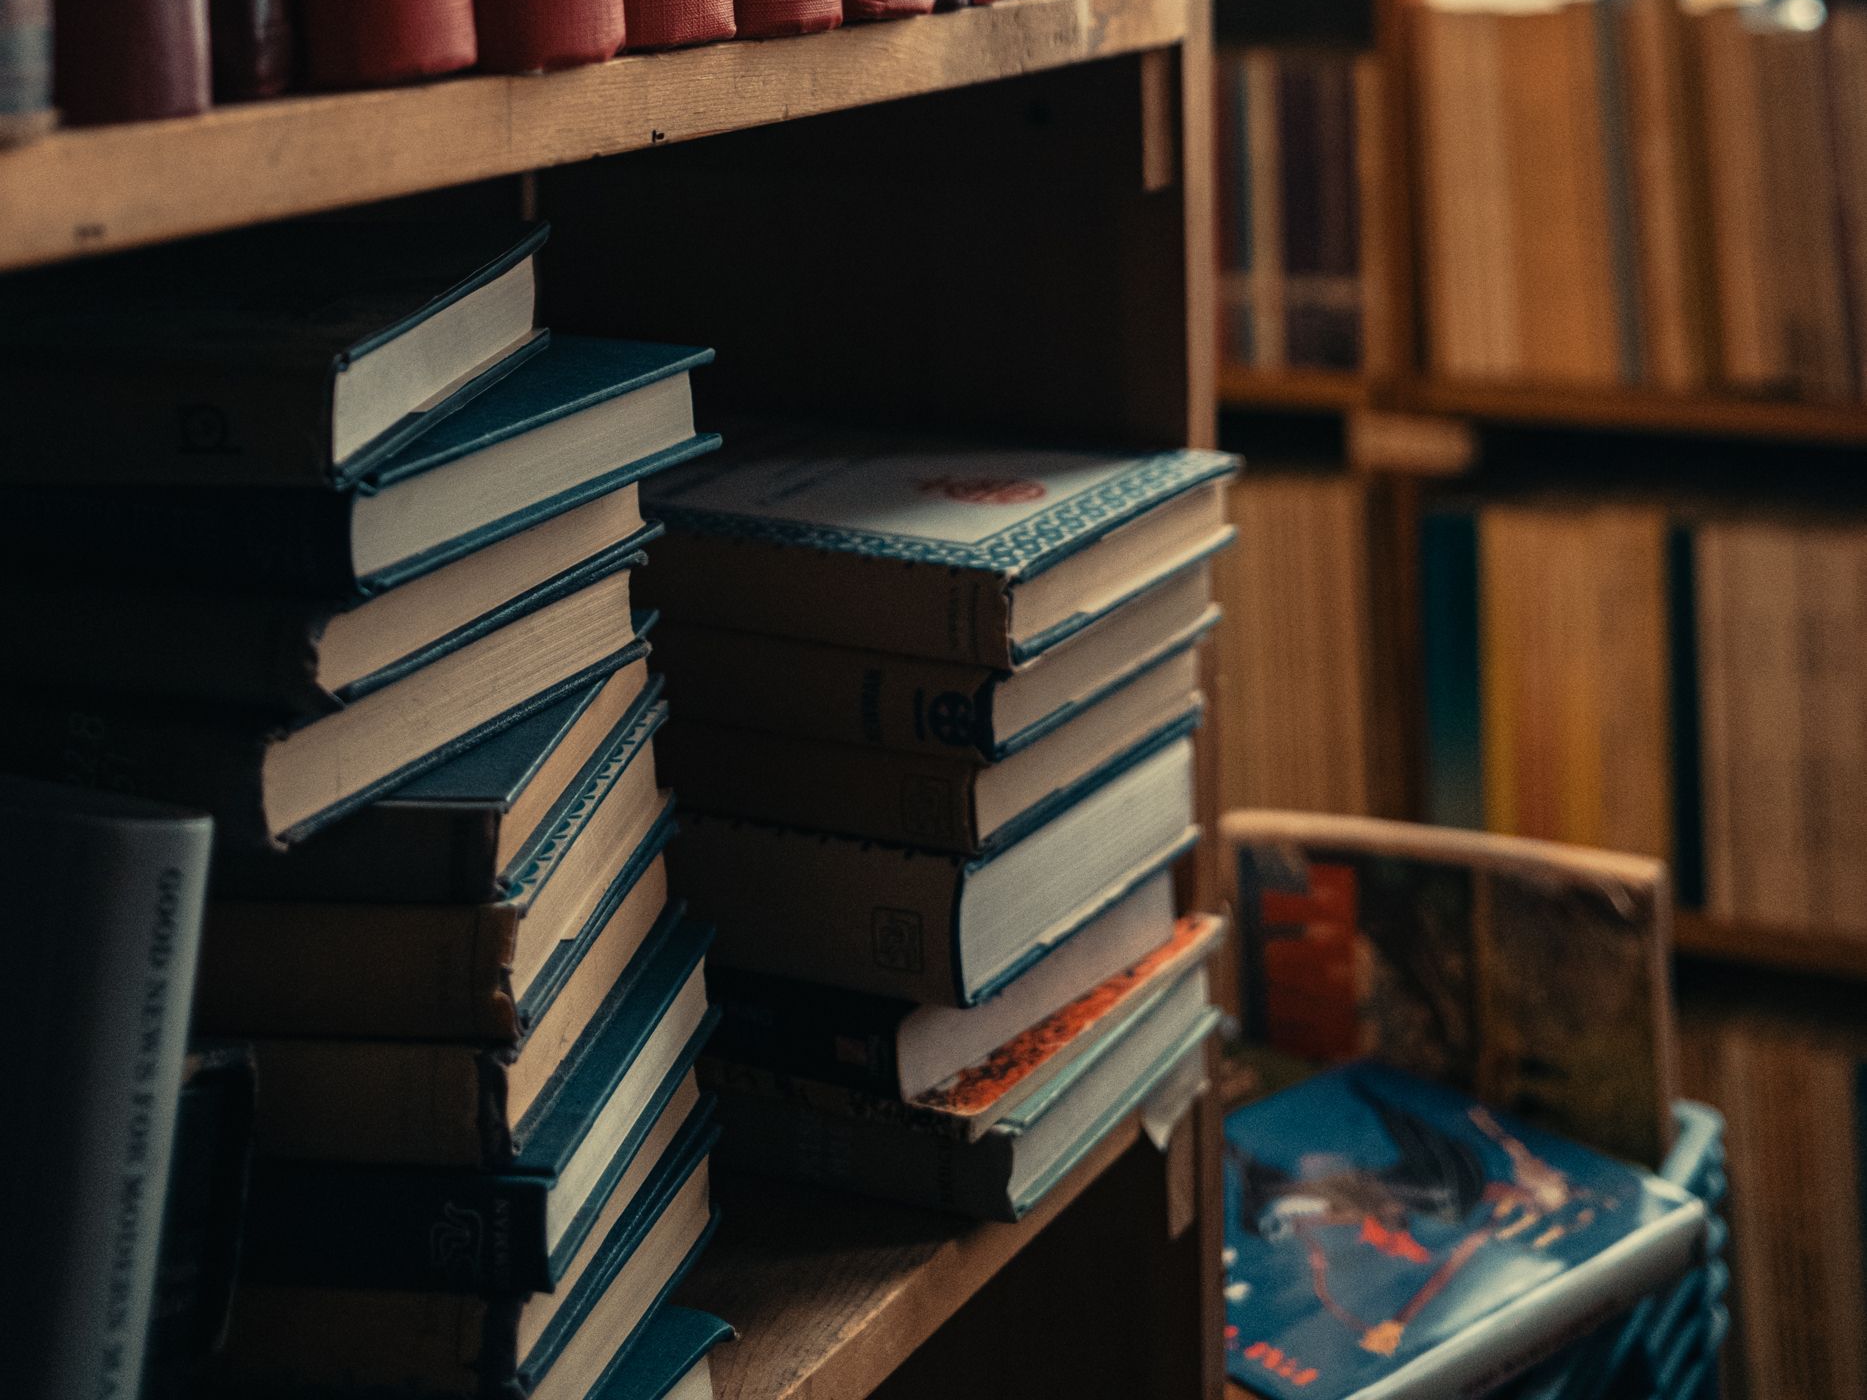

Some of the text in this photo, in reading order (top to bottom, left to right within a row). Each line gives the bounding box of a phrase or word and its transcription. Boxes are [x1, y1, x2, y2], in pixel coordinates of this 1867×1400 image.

[151, 868, 182, 968] GOOD
[134, 978, 167, 1080] NEWS
[126, 1092, 154, 1163] FOR
